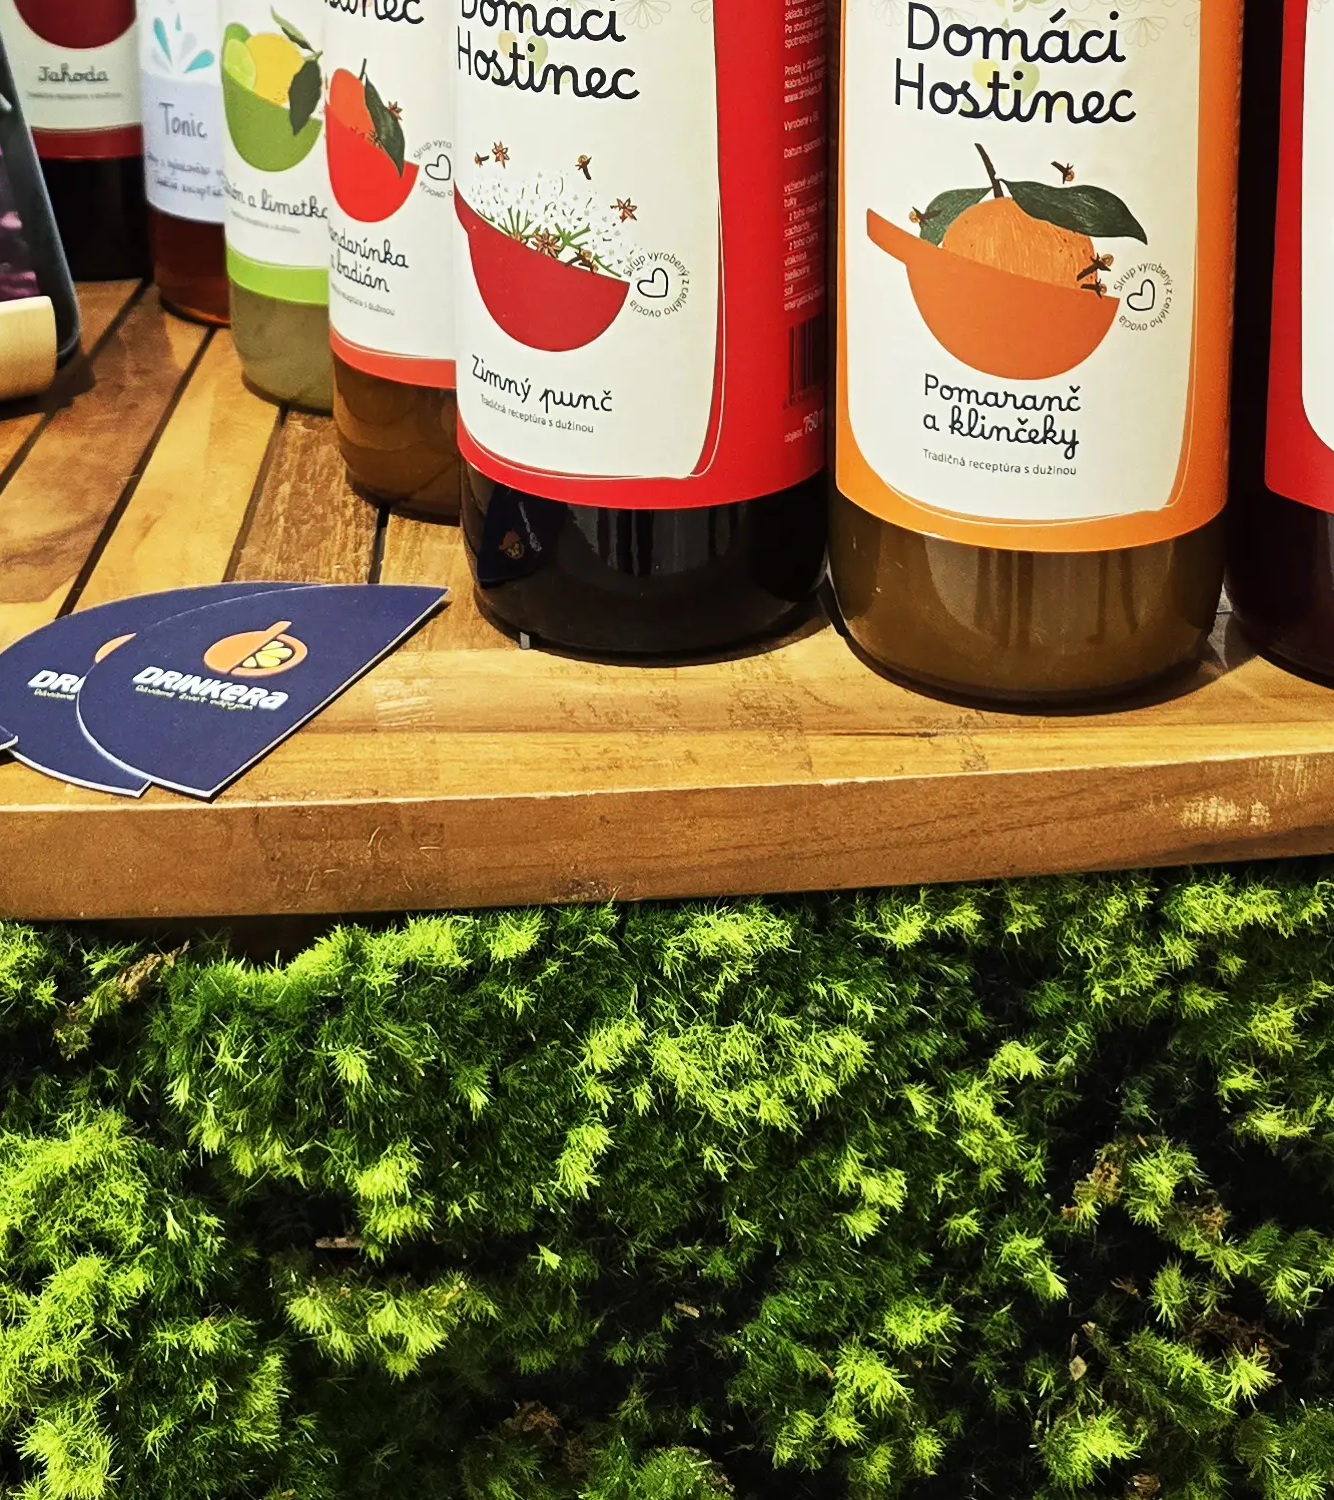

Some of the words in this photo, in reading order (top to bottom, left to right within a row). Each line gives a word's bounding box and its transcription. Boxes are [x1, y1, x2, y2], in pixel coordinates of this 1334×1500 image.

[907, 1, 1126, 63] Domáci
[457, 26, 640, 100] Hostinec
[894, 57, 1137, 124] Hostinec
[471, 354, 532, 404] Zimný
[539, 389, 613, 414] punč
[924, 373, 1081, 412] Pomaranč
[923, 413, 940, 432] a
[948, 405, 1080, 460] klinčeky
[923, 449, 966, 467] Tradičná
[969, 458, 1022, 475] receptúra
[1024, 466, 1030, 475] s
[1033, 464, 1077, 476] dužinou
